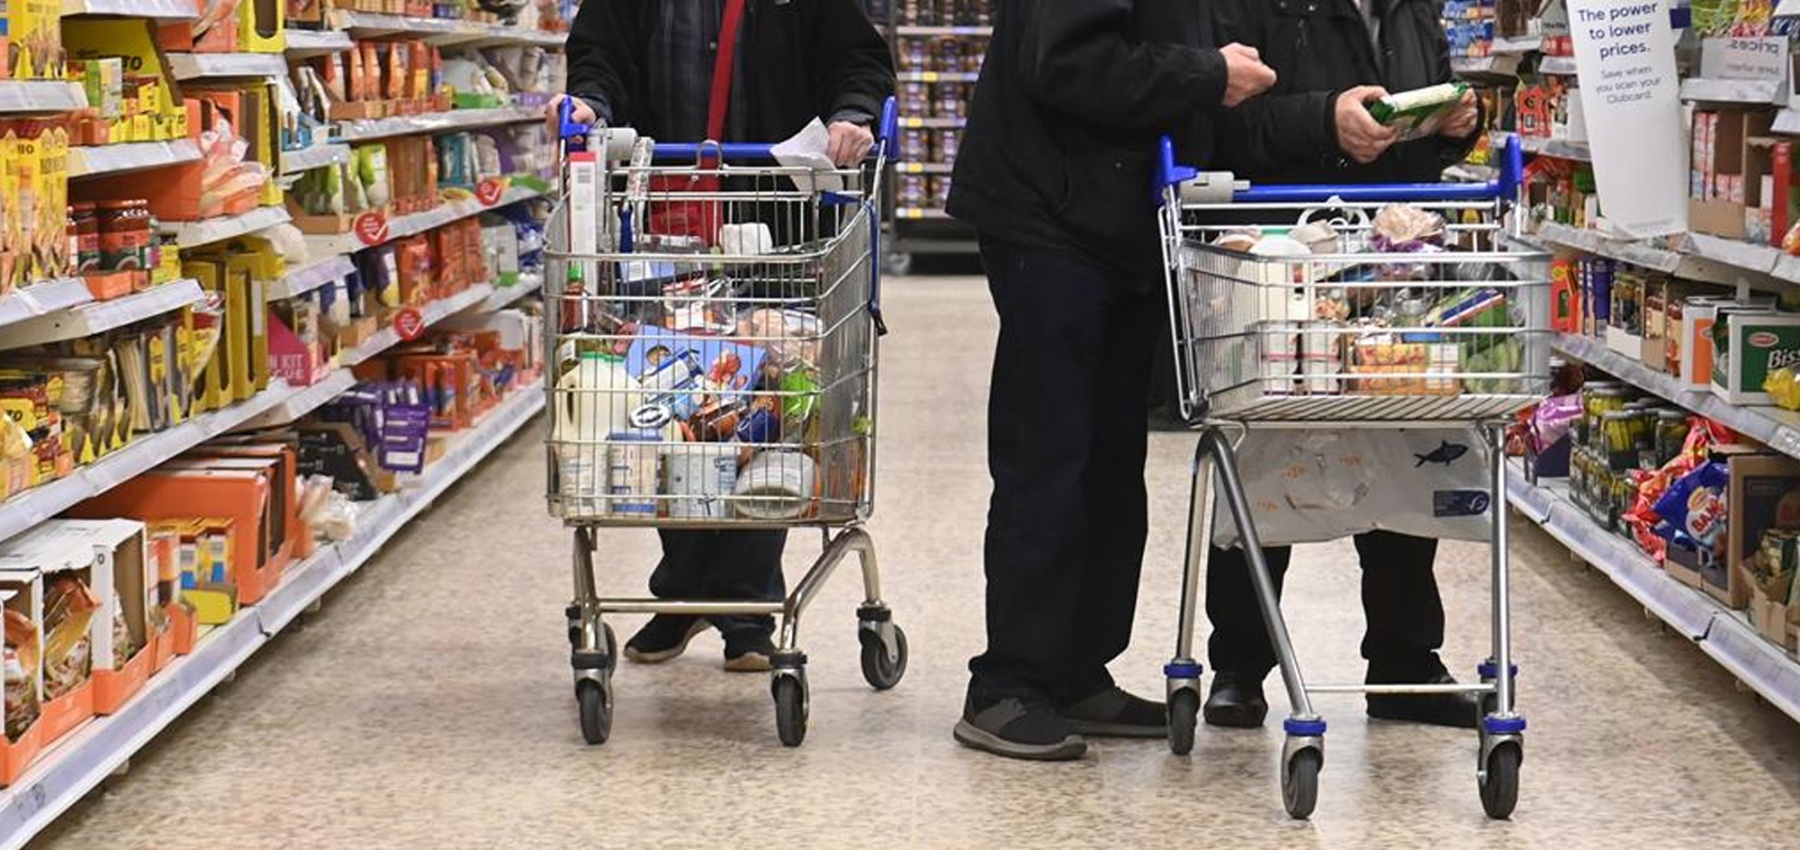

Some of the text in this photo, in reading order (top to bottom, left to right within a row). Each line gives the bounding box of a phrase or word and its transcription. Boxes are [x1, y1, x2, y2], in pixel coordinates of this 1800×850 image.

[1579, 3, 1658, 22] The power
[1589, 23, 1652, 40] to lower
[1600, 42, 1652, 61] prices.
[1625, 66, 1652, 76] when
[1615, 81, 1638, 91] scan
[1640, 77, 1662, 89] your
